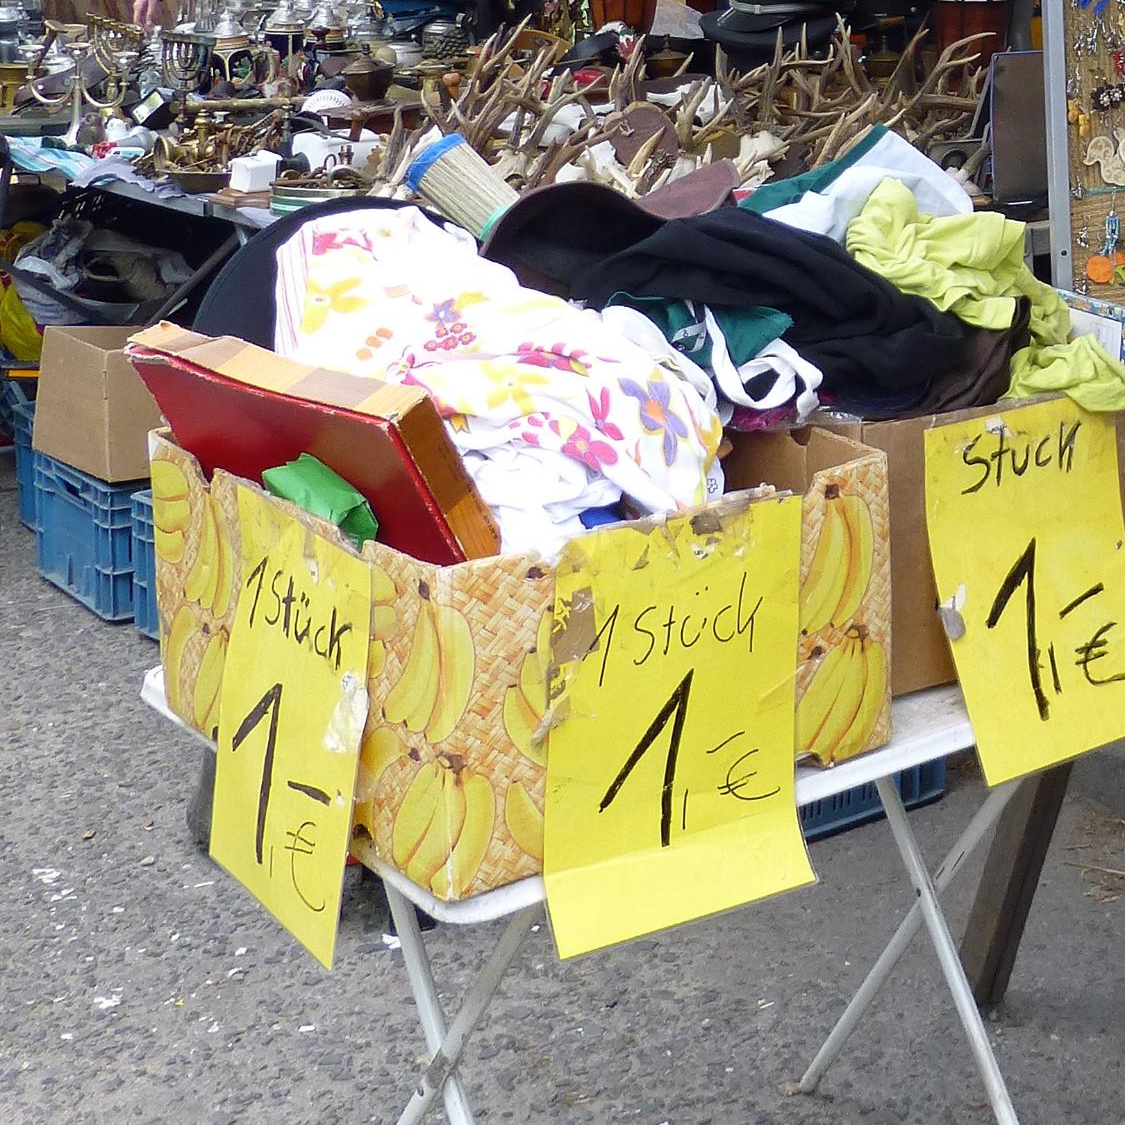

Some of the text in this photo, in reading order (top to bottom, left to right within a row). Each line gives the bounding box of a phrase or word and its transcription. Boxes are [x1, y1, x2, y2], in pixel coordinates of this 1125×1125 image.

[264, 568, 354, 670] Stück
[582, 571, 764, 688] 1 Stück
